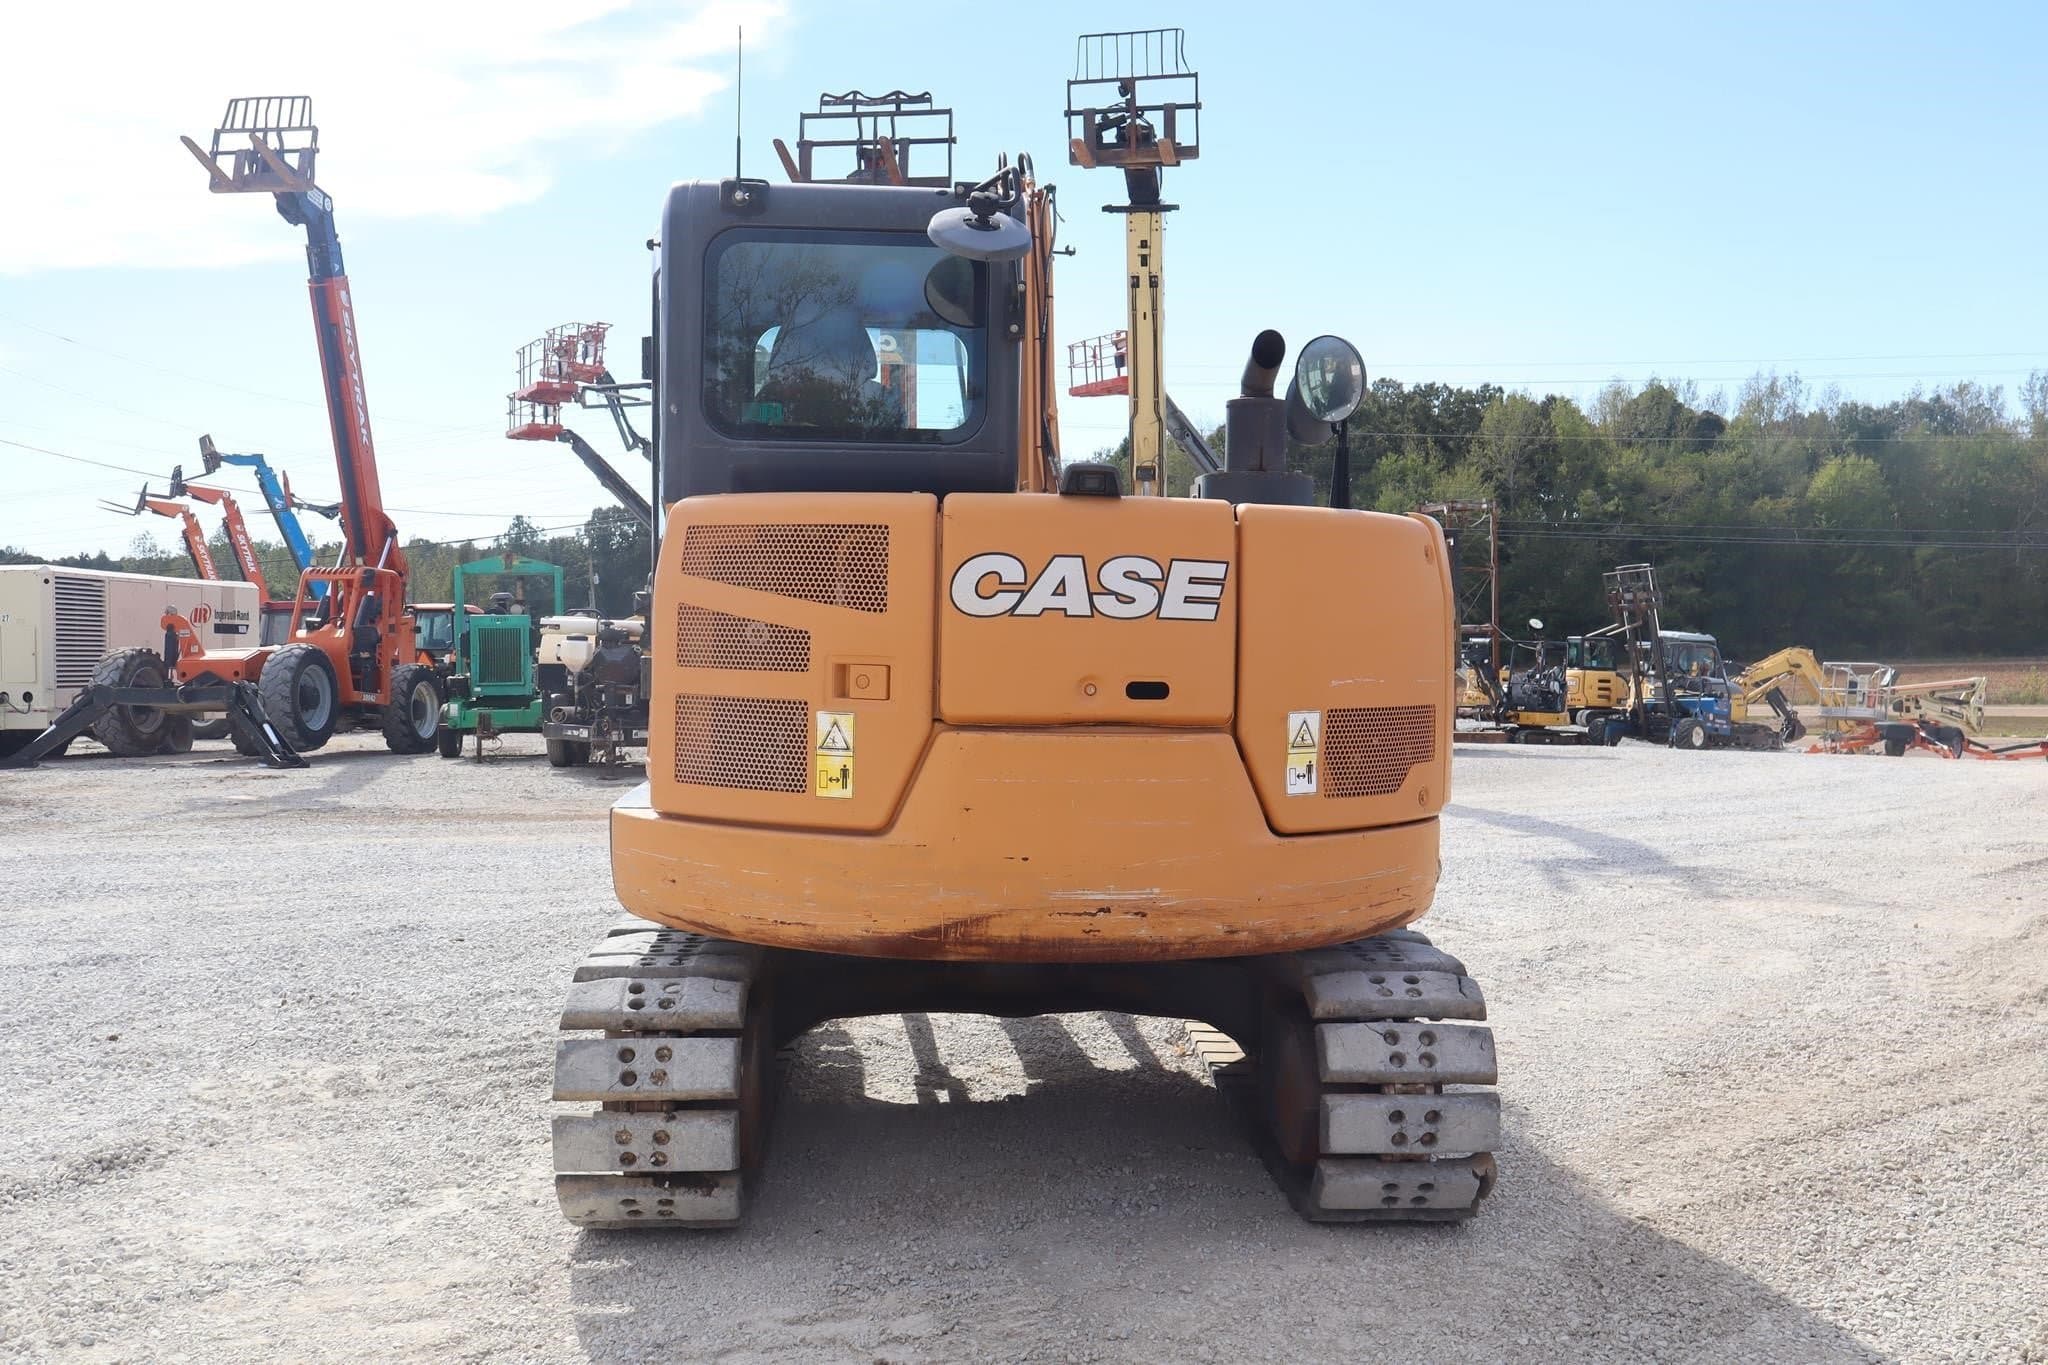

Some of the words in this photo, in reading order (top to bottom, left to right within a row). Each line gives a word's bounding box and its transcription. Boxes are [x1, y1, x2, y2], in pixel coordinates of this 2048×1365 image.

[342, 309, 369, 446] SKYTRAK
[236, 533, 256, 573] SKYTRAK
[950, 552, 1229, 621] CASE
